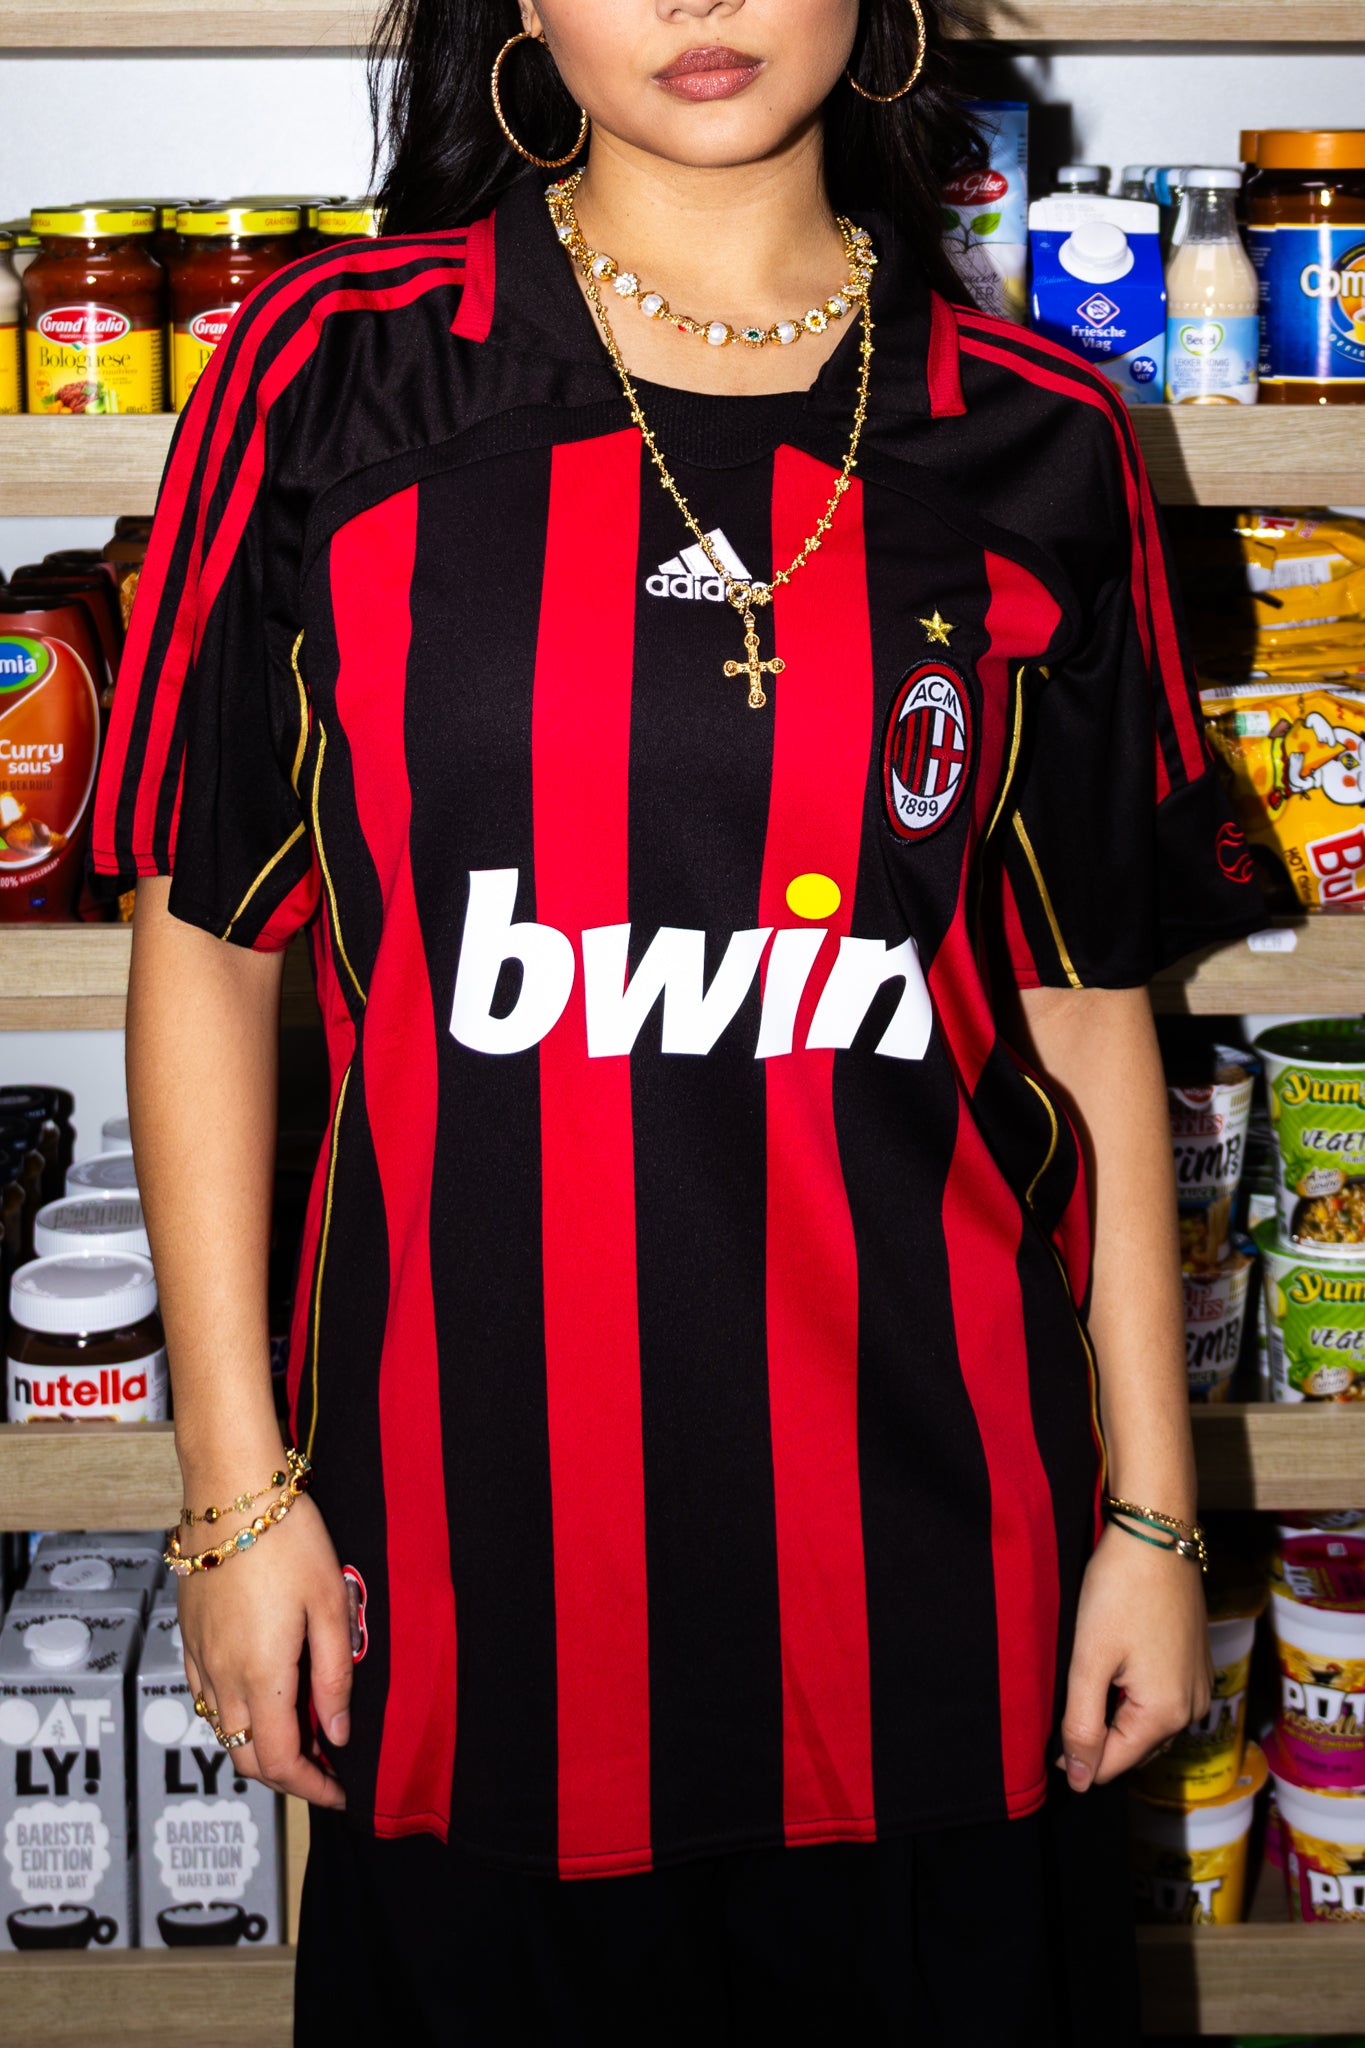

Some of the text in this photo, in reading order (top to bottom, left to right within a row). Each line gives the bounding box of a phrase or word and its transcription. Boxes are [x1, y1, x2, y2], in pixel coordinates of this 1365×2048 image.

[194, 319, 229, 335] Gran
[1071, 325, 1127, 338] Friesche
[1082, 338, 1112, 351] Vlag
[1133, 361, 1154, 373] 0%
[909, 682, 957, 716] ACM
[0, 739, 64, 763] Curry
[8, 758, 51, 774] saus
[900, 794, 939, 817] 1899
[449, 868, 932, 1060] bwin
[14, 1369, 148, 1407] nutella
[21, 1685, 75, 1695] ORIGINAL
[142, 1684, 191, 1697] THE ORI
[16, 1748, 101, 1796] LY!
[165, 1747, 248, 1796] LY!
[17, 1821, 96, 1847] BARISTA
[166, 1820, 245, 1845] BARISTA
[20, 1848, 93, 1872] EDITION
[170, 1846, 243, 1870] EDITION
[27, 1874, 63, 1890] HAFER
[177, 1872, 213, 1888] HAFER
